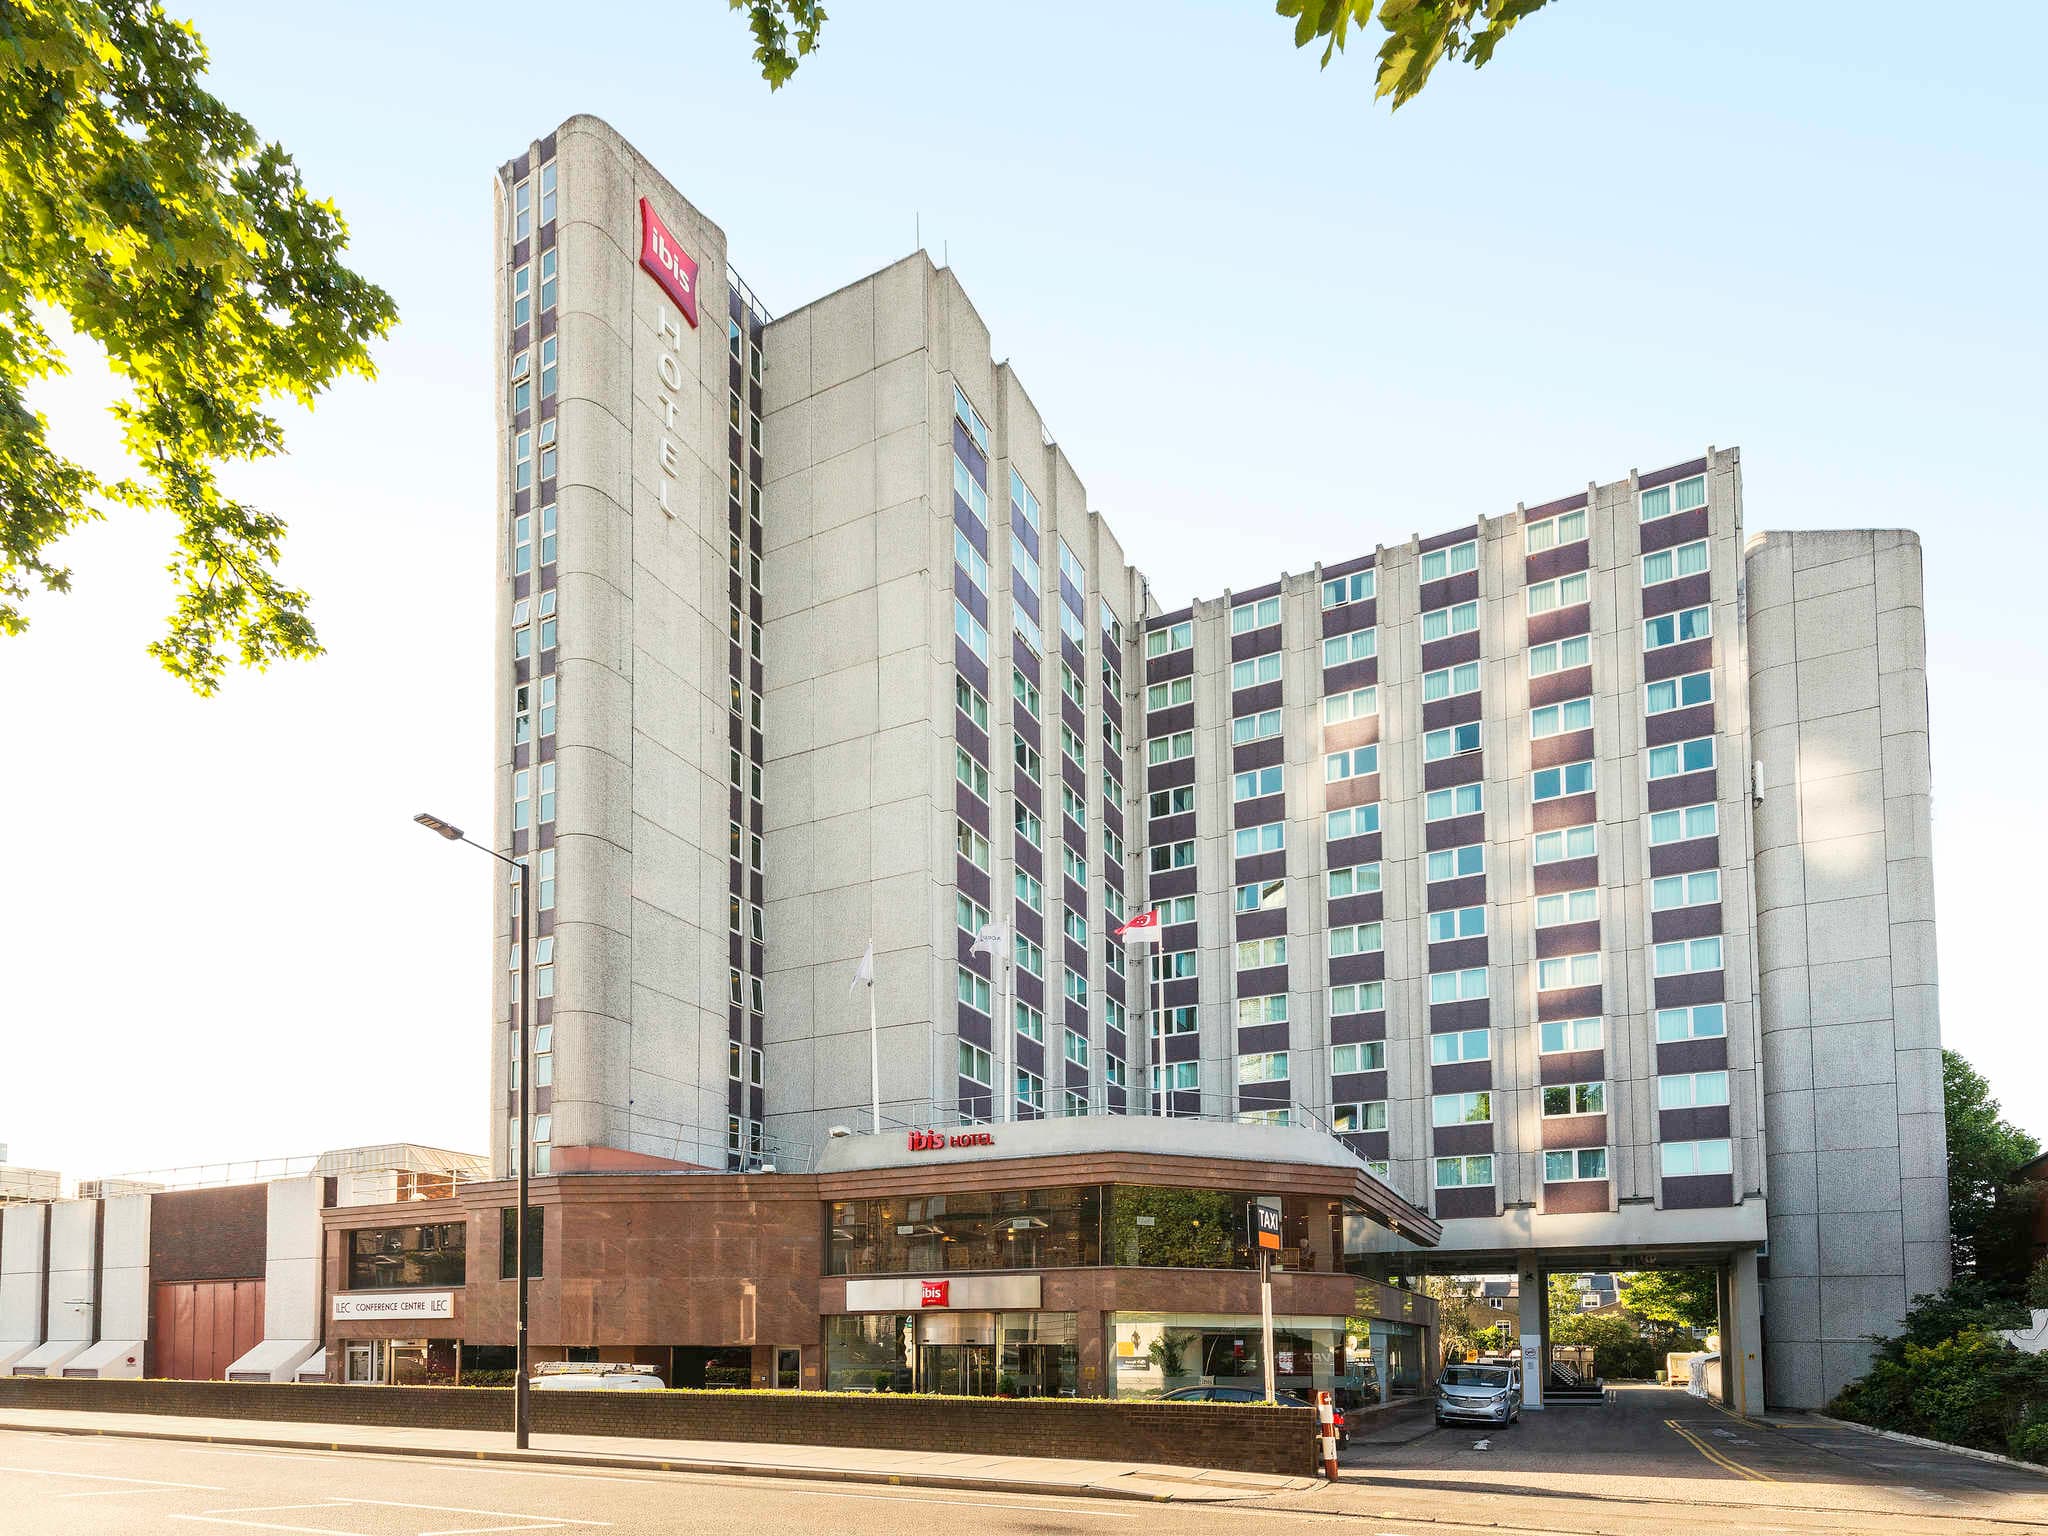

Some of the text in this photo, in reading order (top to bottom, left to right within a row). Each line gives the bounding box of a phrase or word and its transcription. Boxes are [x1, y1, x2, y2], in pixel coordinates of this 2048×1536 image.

[652, 226, 690, 293] ibis
[656, 303, 681, 520] HOTEL
[908, 1129, 995, 1151] ibis HOTEL
[1258, 1209, 1279, 1231] TAXI
[922, 1287, 942, 1298] ibis
[335, 1299, 448, 1314] ILEC CONFERENCE CENTRE ILEC
